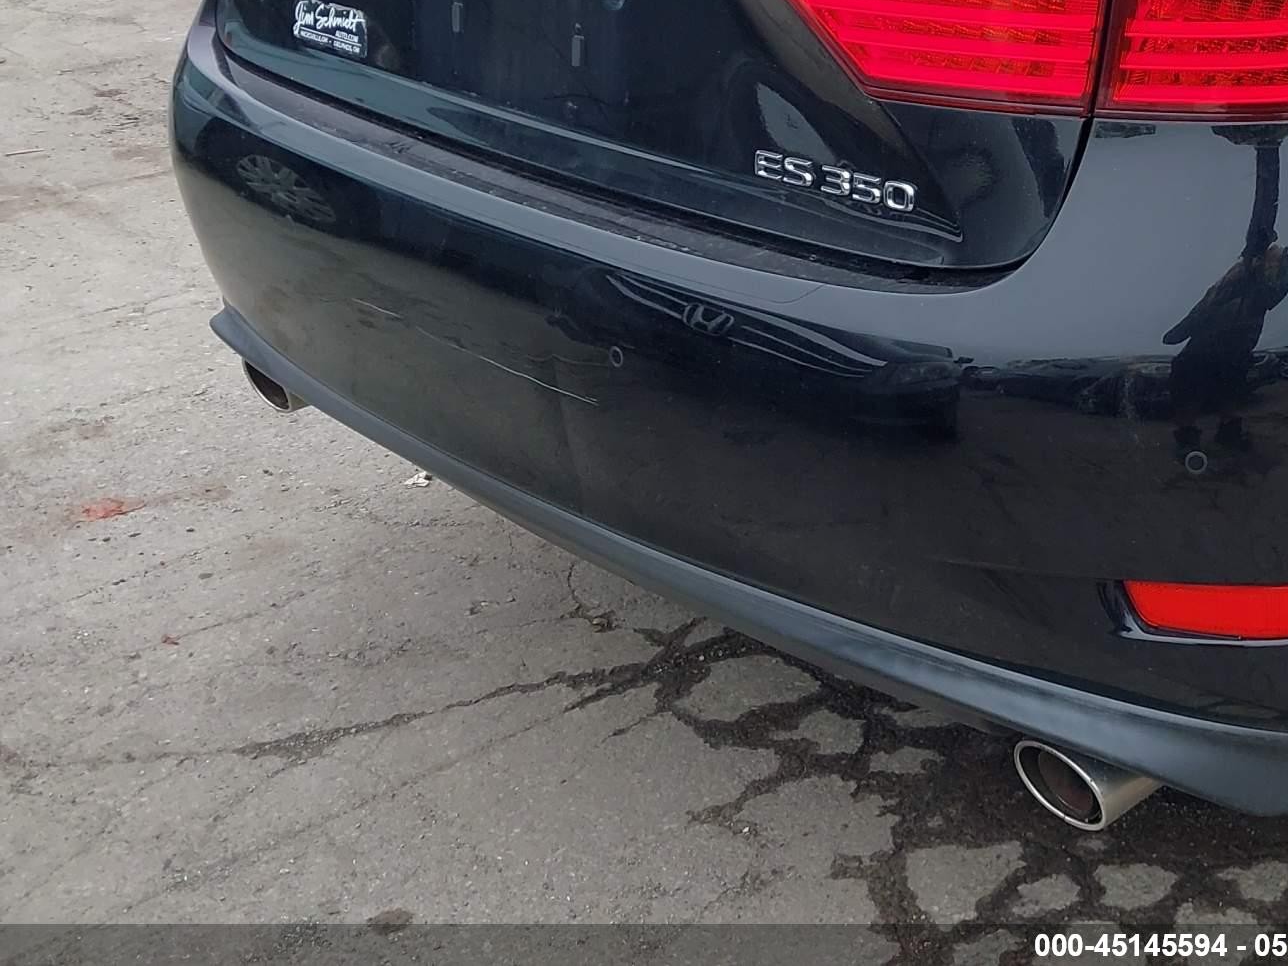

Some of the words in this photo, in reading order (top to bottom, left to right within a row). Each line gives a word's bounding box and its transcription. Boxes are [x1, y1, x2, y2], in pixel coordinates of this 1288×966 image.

[293, 0, 314, 38] Jim
[314, 3, 366, 33] Schmidt
[755, 149, 814, 187] ES
[820, 165, 916, 213] 350
